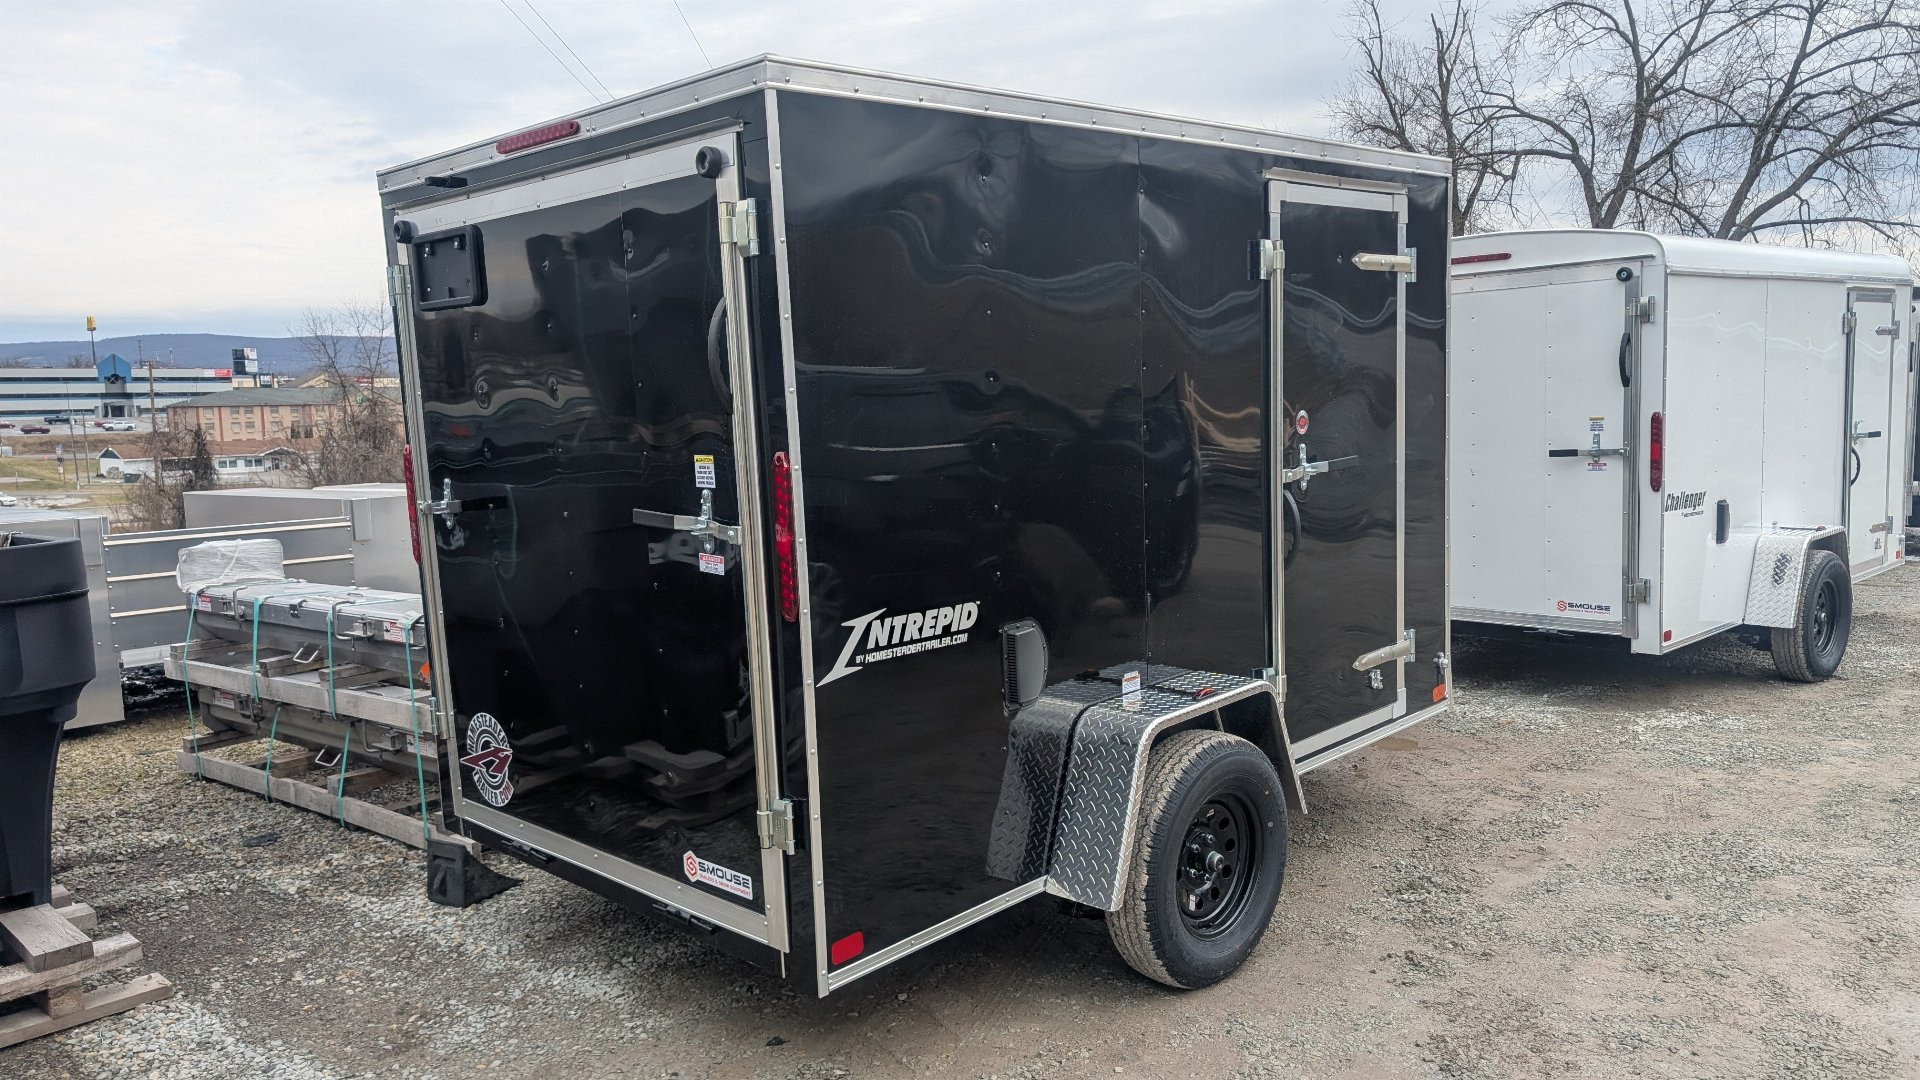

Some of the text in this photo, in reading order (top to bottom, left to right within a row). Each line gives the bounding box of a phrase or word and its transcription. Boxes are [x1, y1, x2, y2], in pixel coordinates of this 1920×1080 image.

[1665, 491, 1707, 512] Challenger
[1568, 602, 1611, 611] SMOUSE
[816, 601, 979, 687] INTREPID
[856, 633, 968, 664] BY HOMESTEADERTRAILER.COM
[698, 861, 750, 889] SMOUSE
